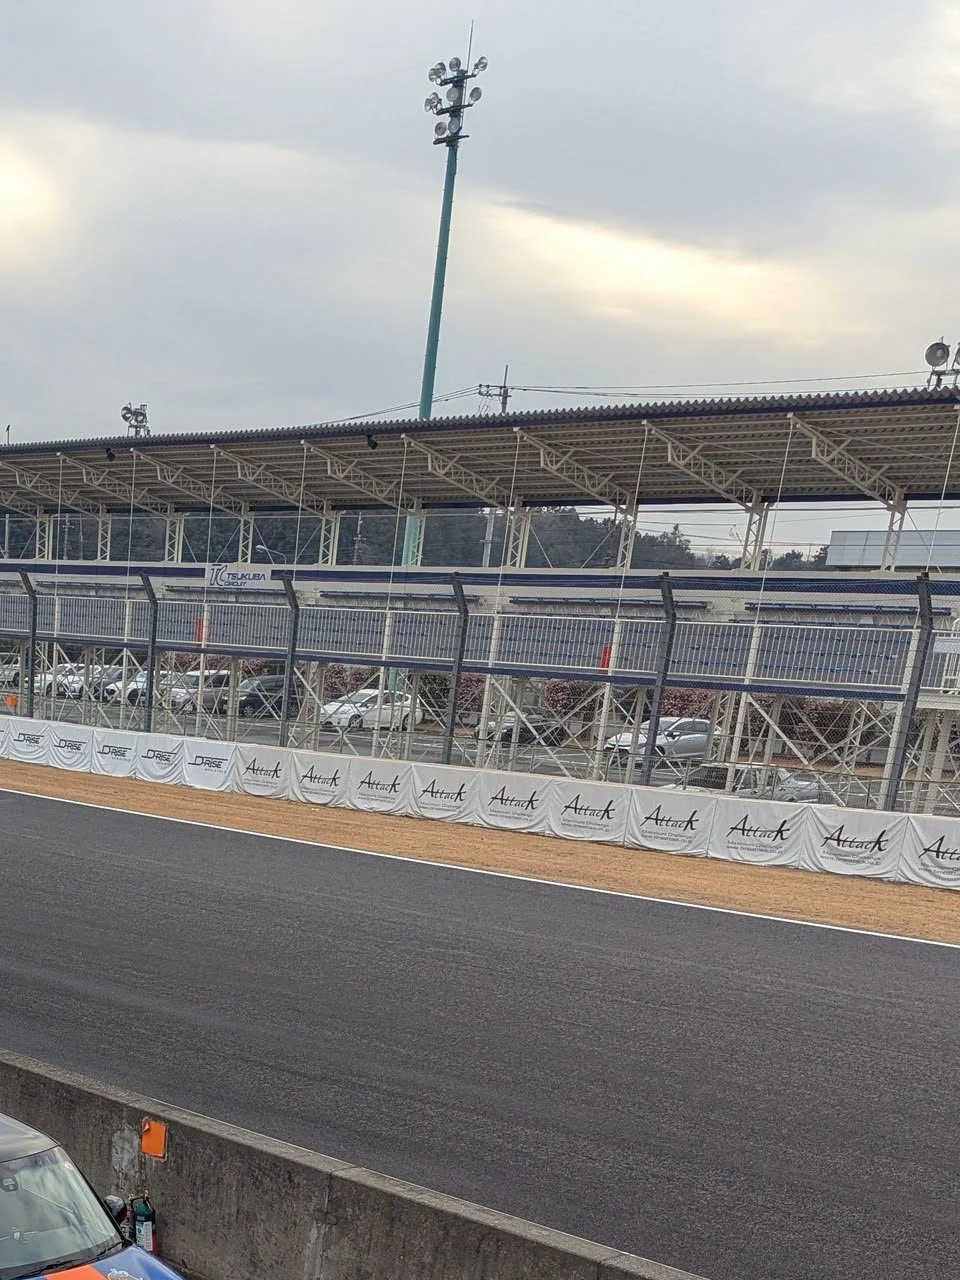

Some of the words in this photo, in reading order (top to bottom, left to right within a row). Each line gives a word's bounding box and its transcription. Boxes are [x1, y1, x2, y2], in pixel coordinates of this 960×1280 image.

[227, 572, 266, 581] TSUKUBA
[243, 758, 282, 778] Attack
[300, 765, 340, 787] Attack
[358, 771, 400, 793] Attack
[418, 779, 466, 802] Attack
[488, 786, 539, 810] Attack
[561, 794, 615, 820] Attack
[640, 805, 699, 831] Attack
[726, 814, 790, 841] Attack
[820, 824, 888, 853] Attack
